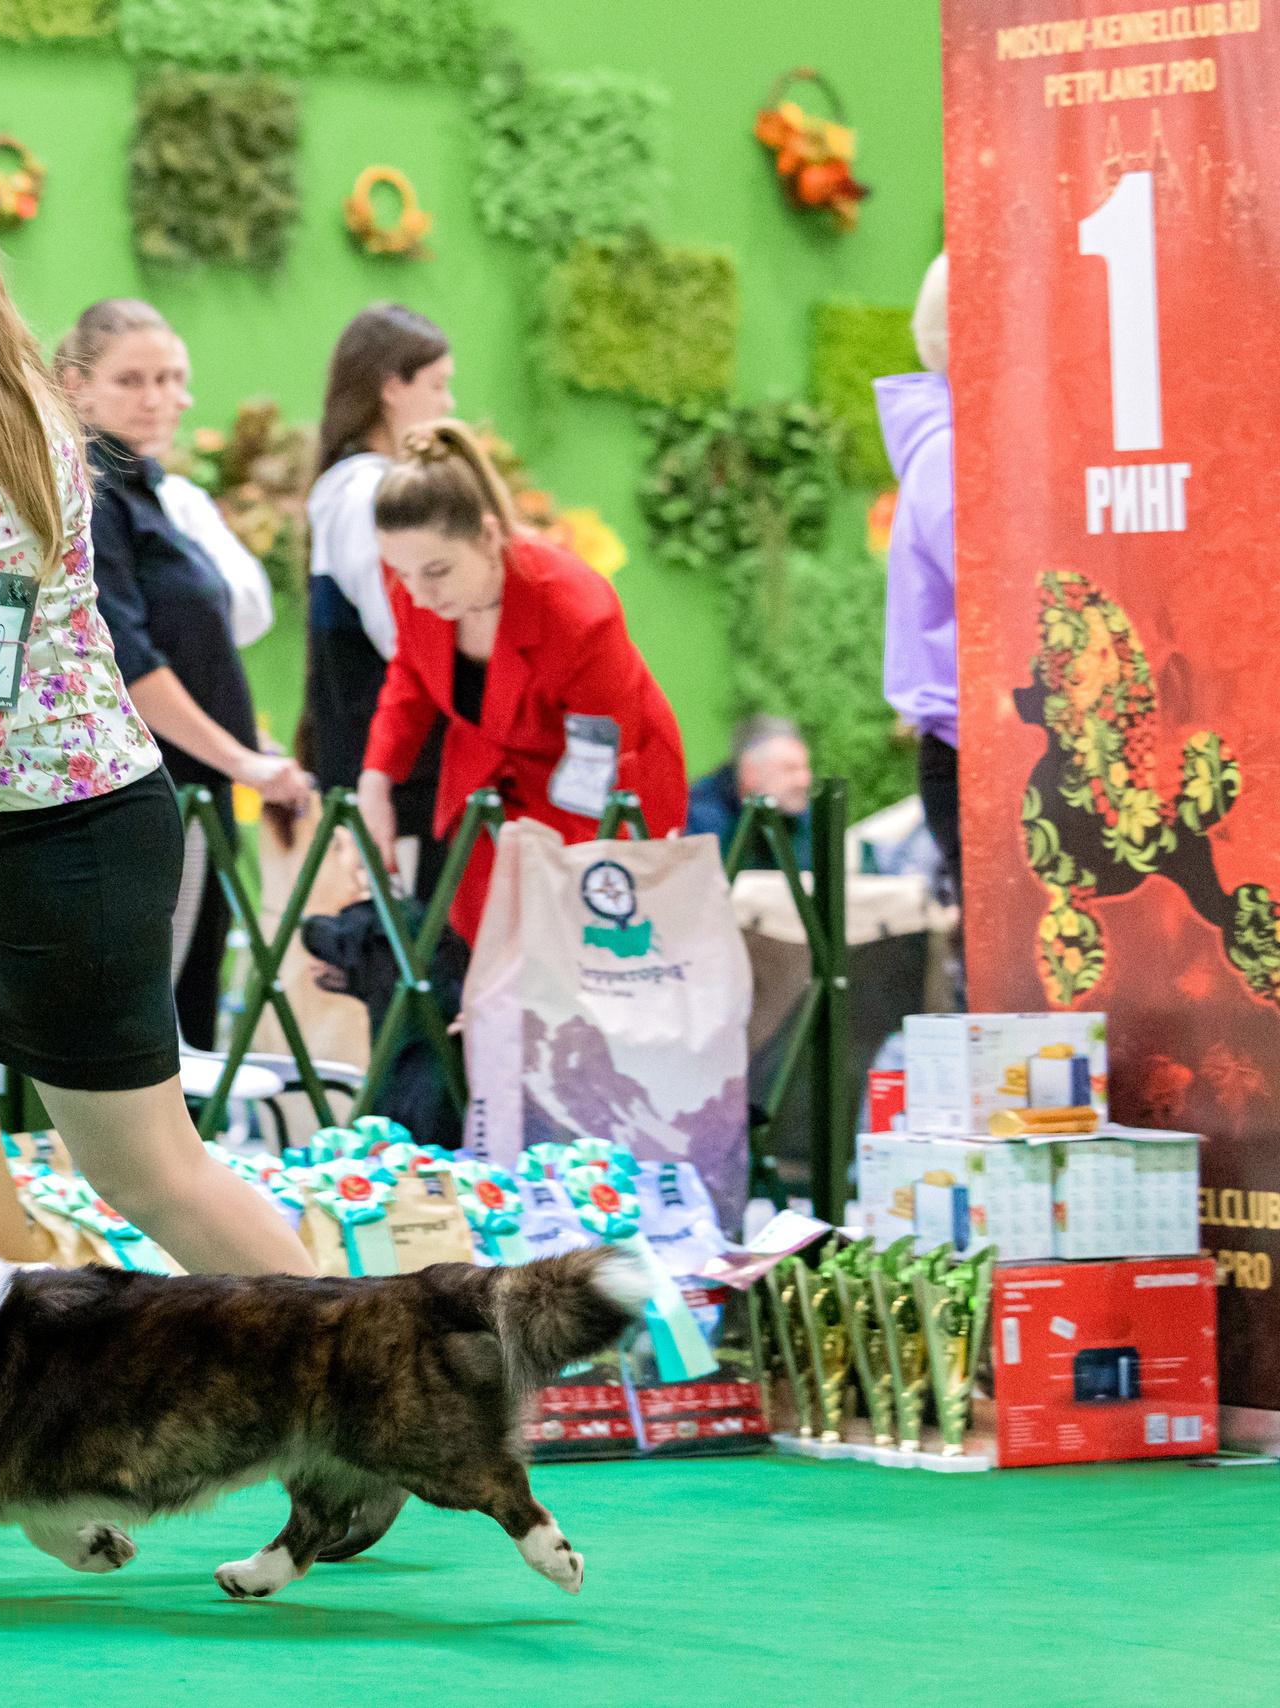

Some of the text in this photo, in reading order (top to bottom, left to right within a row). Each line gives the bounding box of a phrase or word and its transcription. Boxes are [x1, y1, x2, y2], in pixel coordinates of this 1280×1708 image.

[997, 0, 1261, 60] MOSCOW-KENNELCLUB.RU
[1044, 57, 1216, 108] PETPLANET.PRO
[1078, 170, 1162, 452] 1
[1086, 462, 1191, 535] РИНГ
